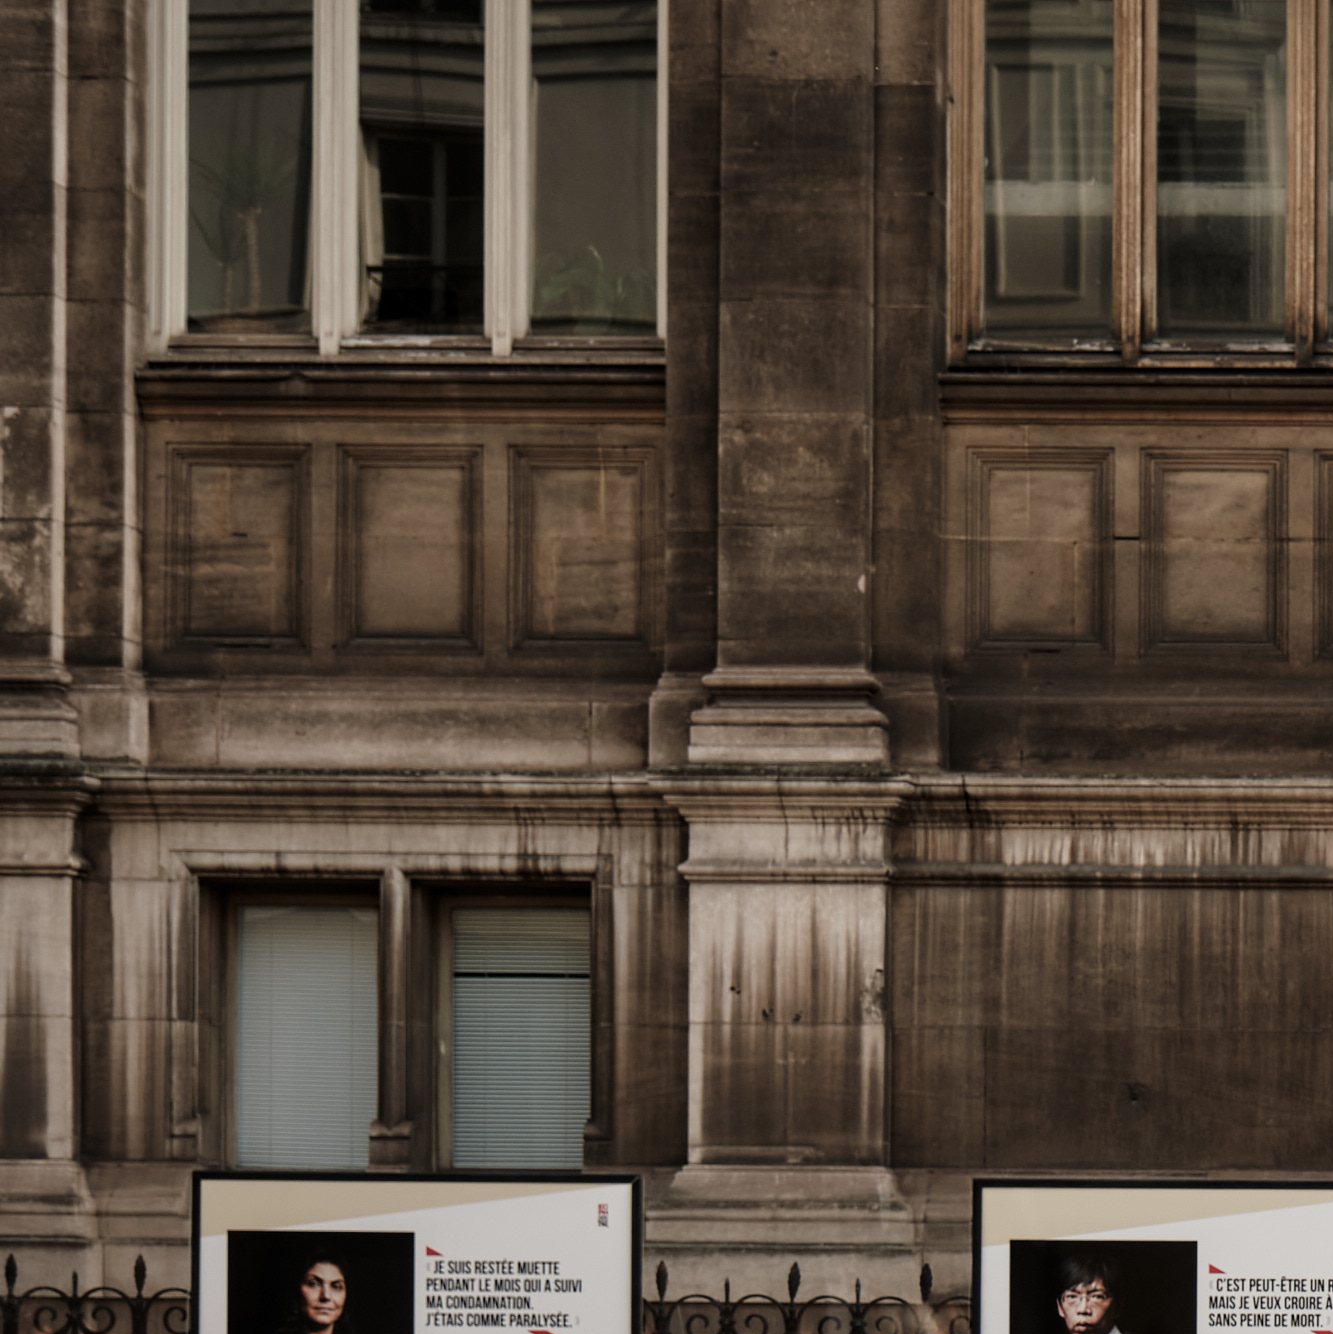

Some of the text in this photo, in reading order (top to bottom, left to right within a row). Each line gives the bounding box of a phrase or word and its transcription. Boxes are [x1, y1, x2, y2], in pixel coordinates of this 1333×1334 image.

[433, 1258, 560, 1275] JE SUIS RESTÉE MUETTE
[425, 1278, 582, 1293] PENDANT LE MOIS QUI A SUIVI
[1216, 1279, 1245, 1292] C'EST
[1249, 1277, 1307, 1292] PEUT-ÊTRE
[1310, 1280, 1325, 1292] UN
[425, 1296, 534, 1310] MA CONDAMNATION.
[1208, 1296, 1236, 1309] MAIS
[1239, 1296, 1249, 1310] JE
[1253, 1296, 1281, 1310] VEUX
[1284, 1297, 1322, 1310] CROIRE
[1325, 1294, 1333, 1310] À
[426, 1311, 573, 1327] J'ÉTAIS COMME PARALYSÉE.
[1208, 1314, 1323, 1327] SANS PEINE DE MORT.
